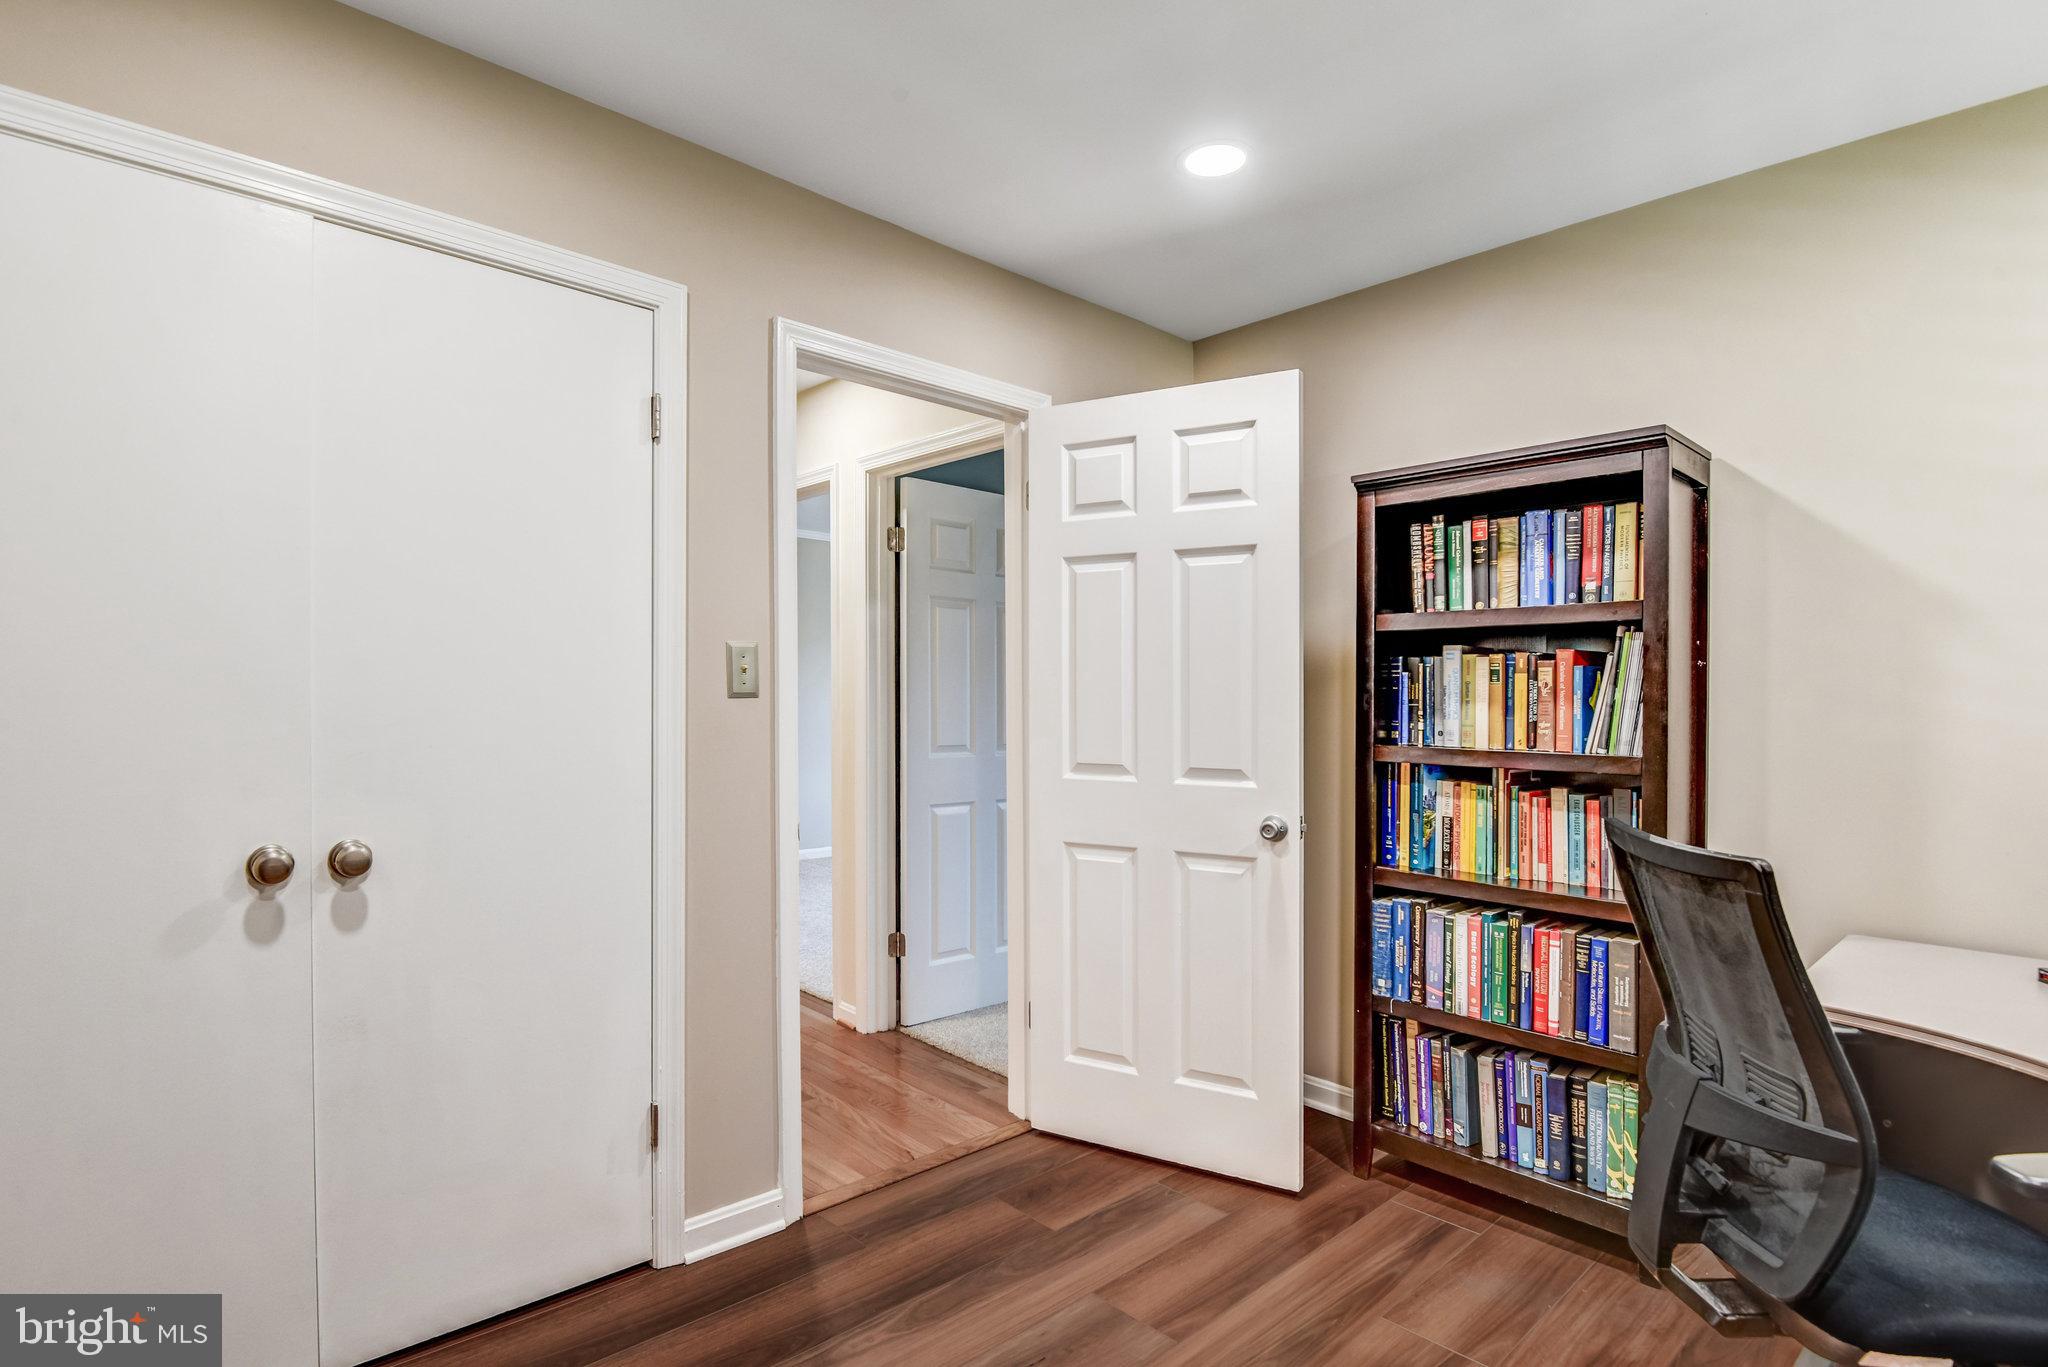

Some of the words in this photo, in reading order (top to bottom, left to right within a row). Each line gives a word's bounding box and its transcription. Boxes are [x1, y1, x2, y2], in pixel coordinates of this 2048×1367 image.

[1411, 526, 1421, 567] BOMBSHELL
[1424, 526, 1434, 546] DAY
[1424, 546, 1434, 572] ONE
[1540, 963, 1548, 994] RADIATION
